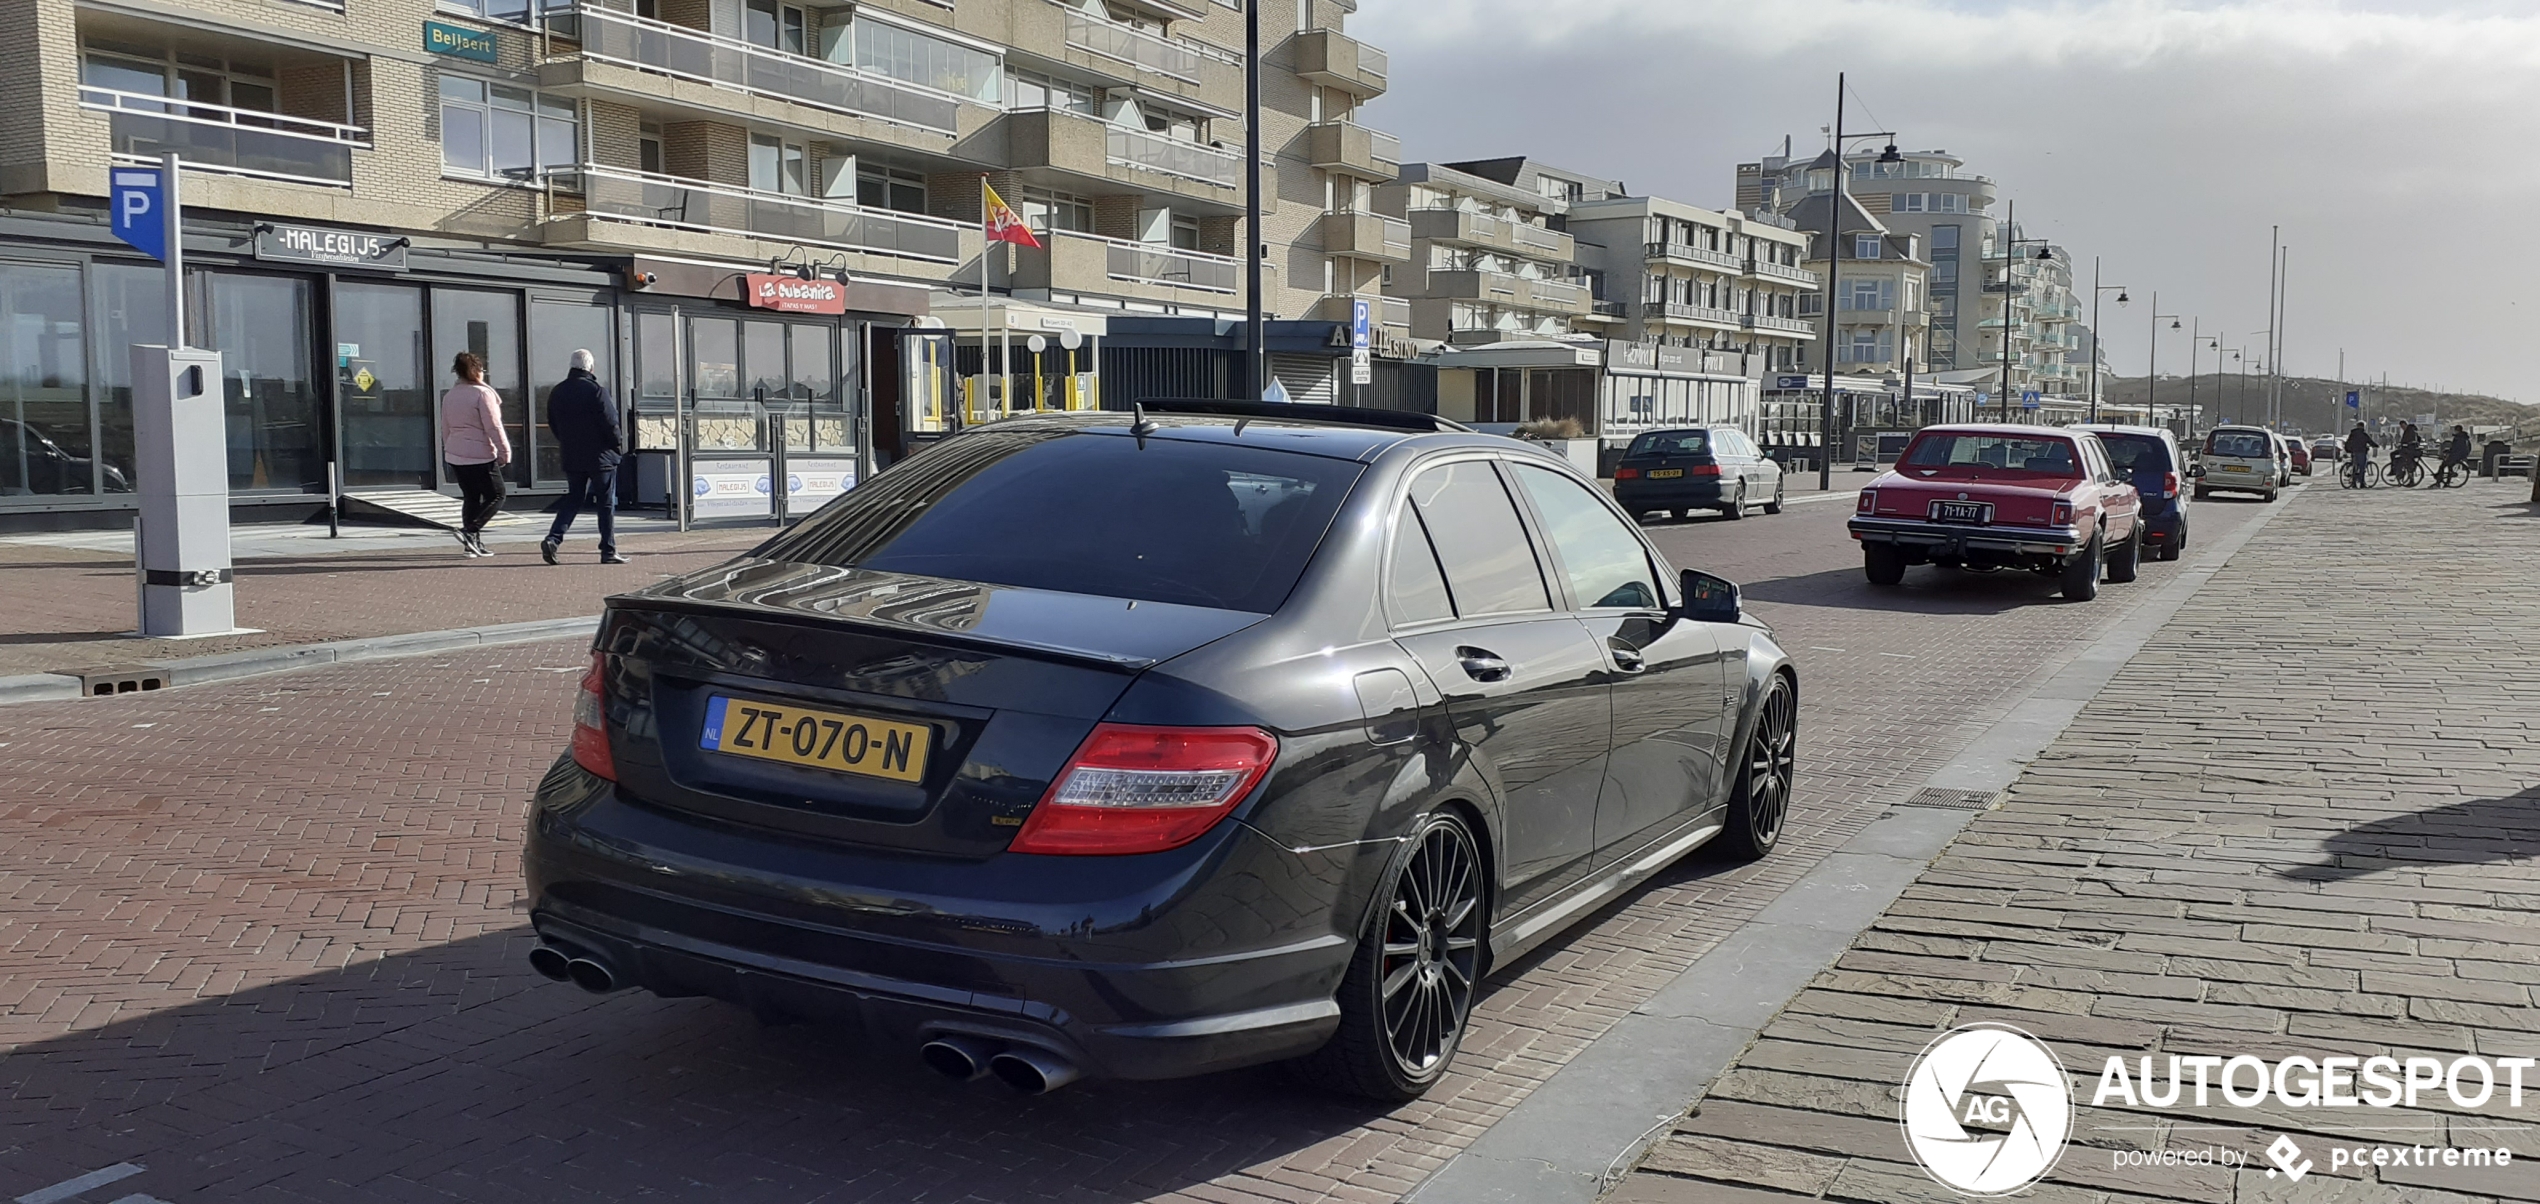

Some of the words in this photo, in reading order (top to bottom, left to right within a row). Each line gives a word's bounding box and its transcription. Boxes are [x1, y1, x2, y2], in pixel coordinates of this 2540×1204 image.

[432, 29, 491, 53] Beijaert
[123, 191, 149, 228] P
[759, 282, 776, 297] La
[1358, 305, 1366, 328] P
[1379, 339, 1419, 360] CASINO
[719, 483, 747, 491] MALEGIJS
[1944, 505, 1978, 518] 71-YA-77
[705, 728, 718, 740] NL
[733, 707, 913, 773] ZT-070-N
